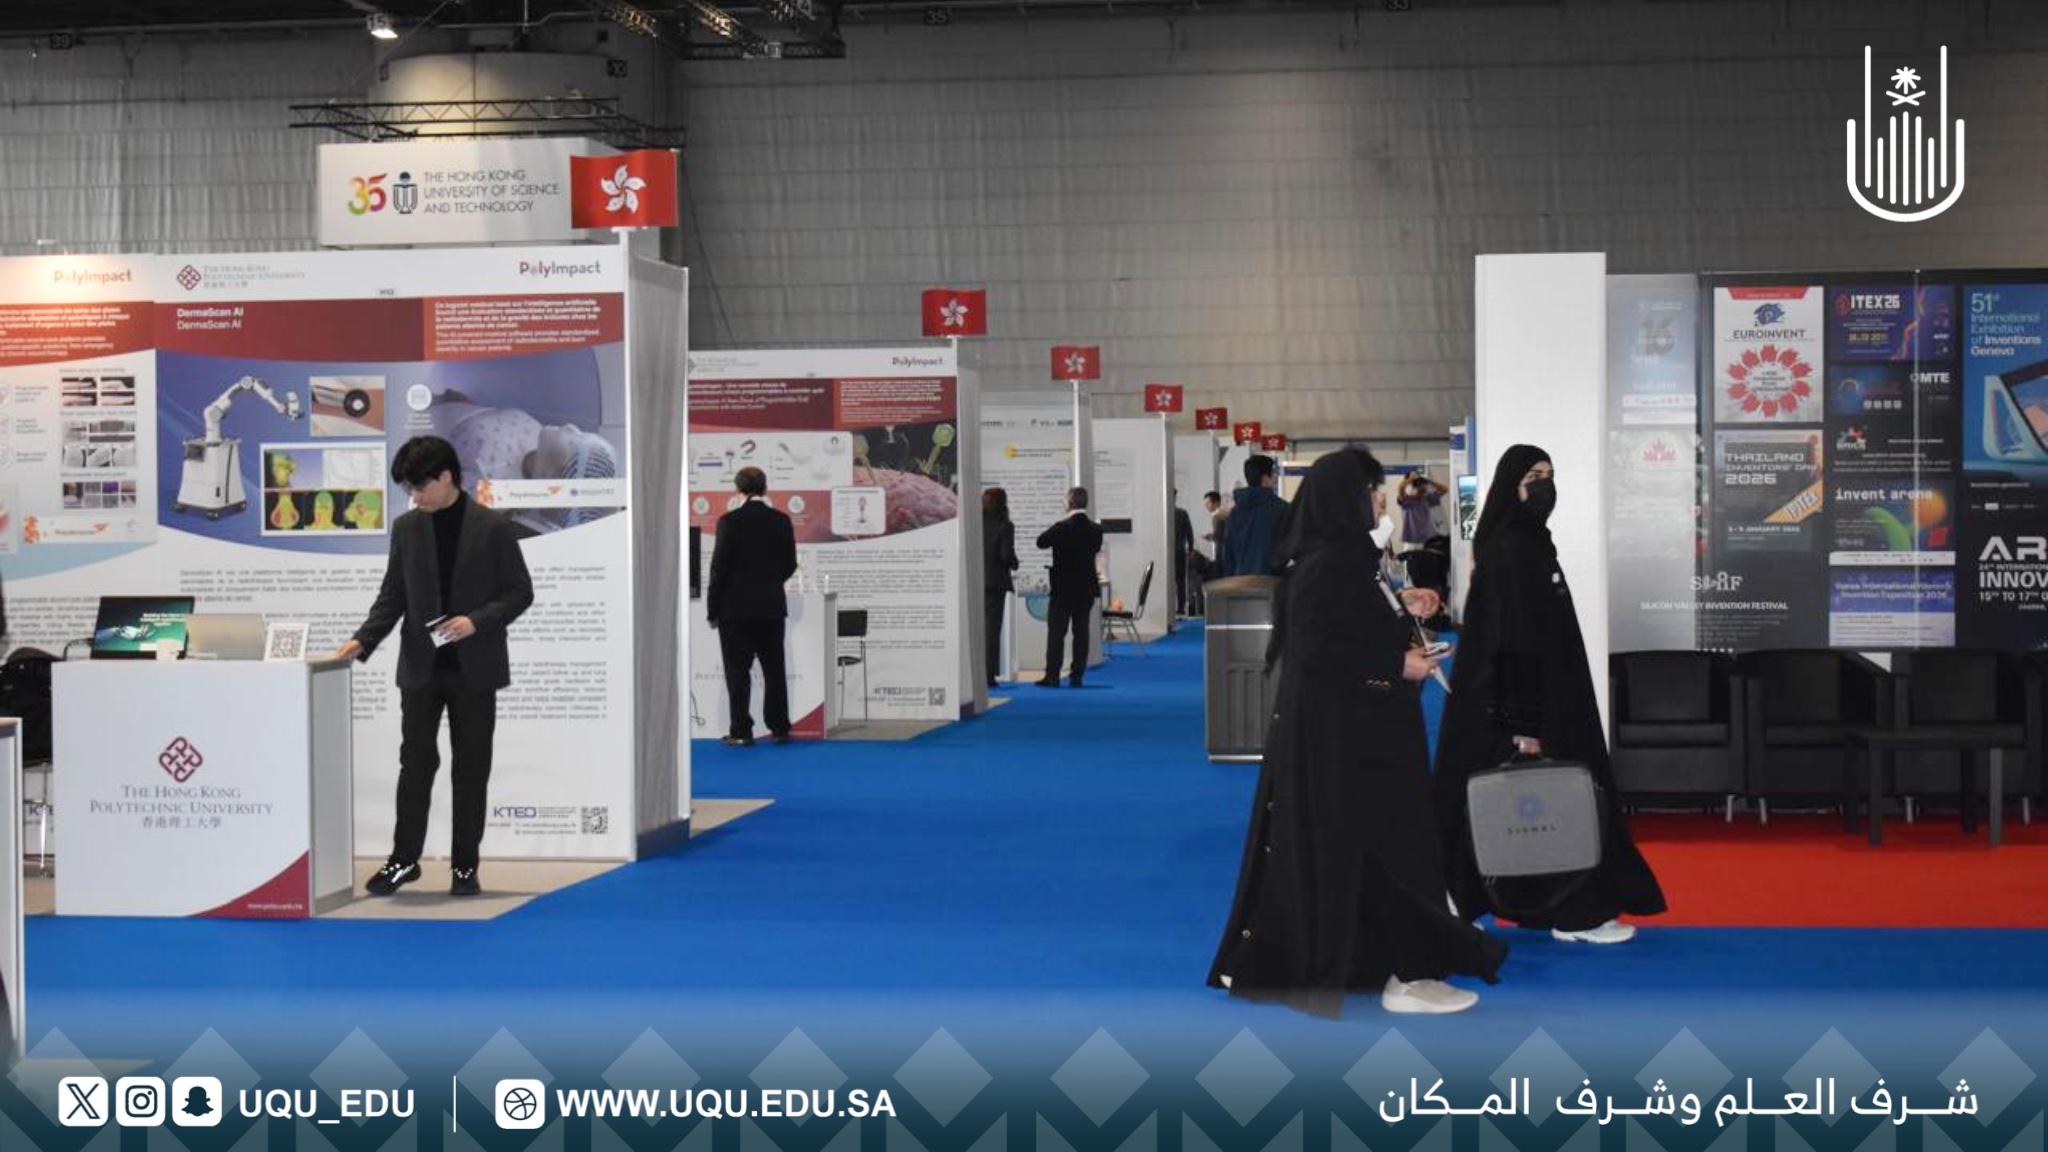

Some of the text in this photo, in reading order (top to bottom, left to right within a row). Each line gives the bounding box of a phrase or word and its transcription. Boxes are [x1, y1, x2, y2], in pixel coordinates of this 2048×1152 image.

[424, 170, 526, 183] THE HONG KONG
[424, 183, 560, 199] UNIVERSITY OF SCIENCE
[424, 200, 534, 214] AND TECHNOLOGY
[519, 260, 601, 278] PolyImpact
[53, 269, 132, 286] PolyImpact
[177, 308, 244, 318] DermaScan AI
[1971, 313, 2040, 322] International
[177, 319, 242, 330] DermaScan AI
[1971, 324, 2024, 334] Exhibition
[1733, 329, 1806, 340] EUROINVENT
[1971, 334, 2041, 344] of Inventions
[1971, 346, 2014, 356] Geneva
[1725, 452, 1804, 464] THAILAND
[1724, 474, 1778, 485] 2026
[1835, 488, 1933, 500] invent arena
[1706, 602, 1750, 610] INVENTION
[1752, 602, 1788, 610] FESTIVAL
[121, 784, 241, 798] THE HONG KONG
[90, 801, 274, 814] POLYTECHNIC UNIVERSITY
